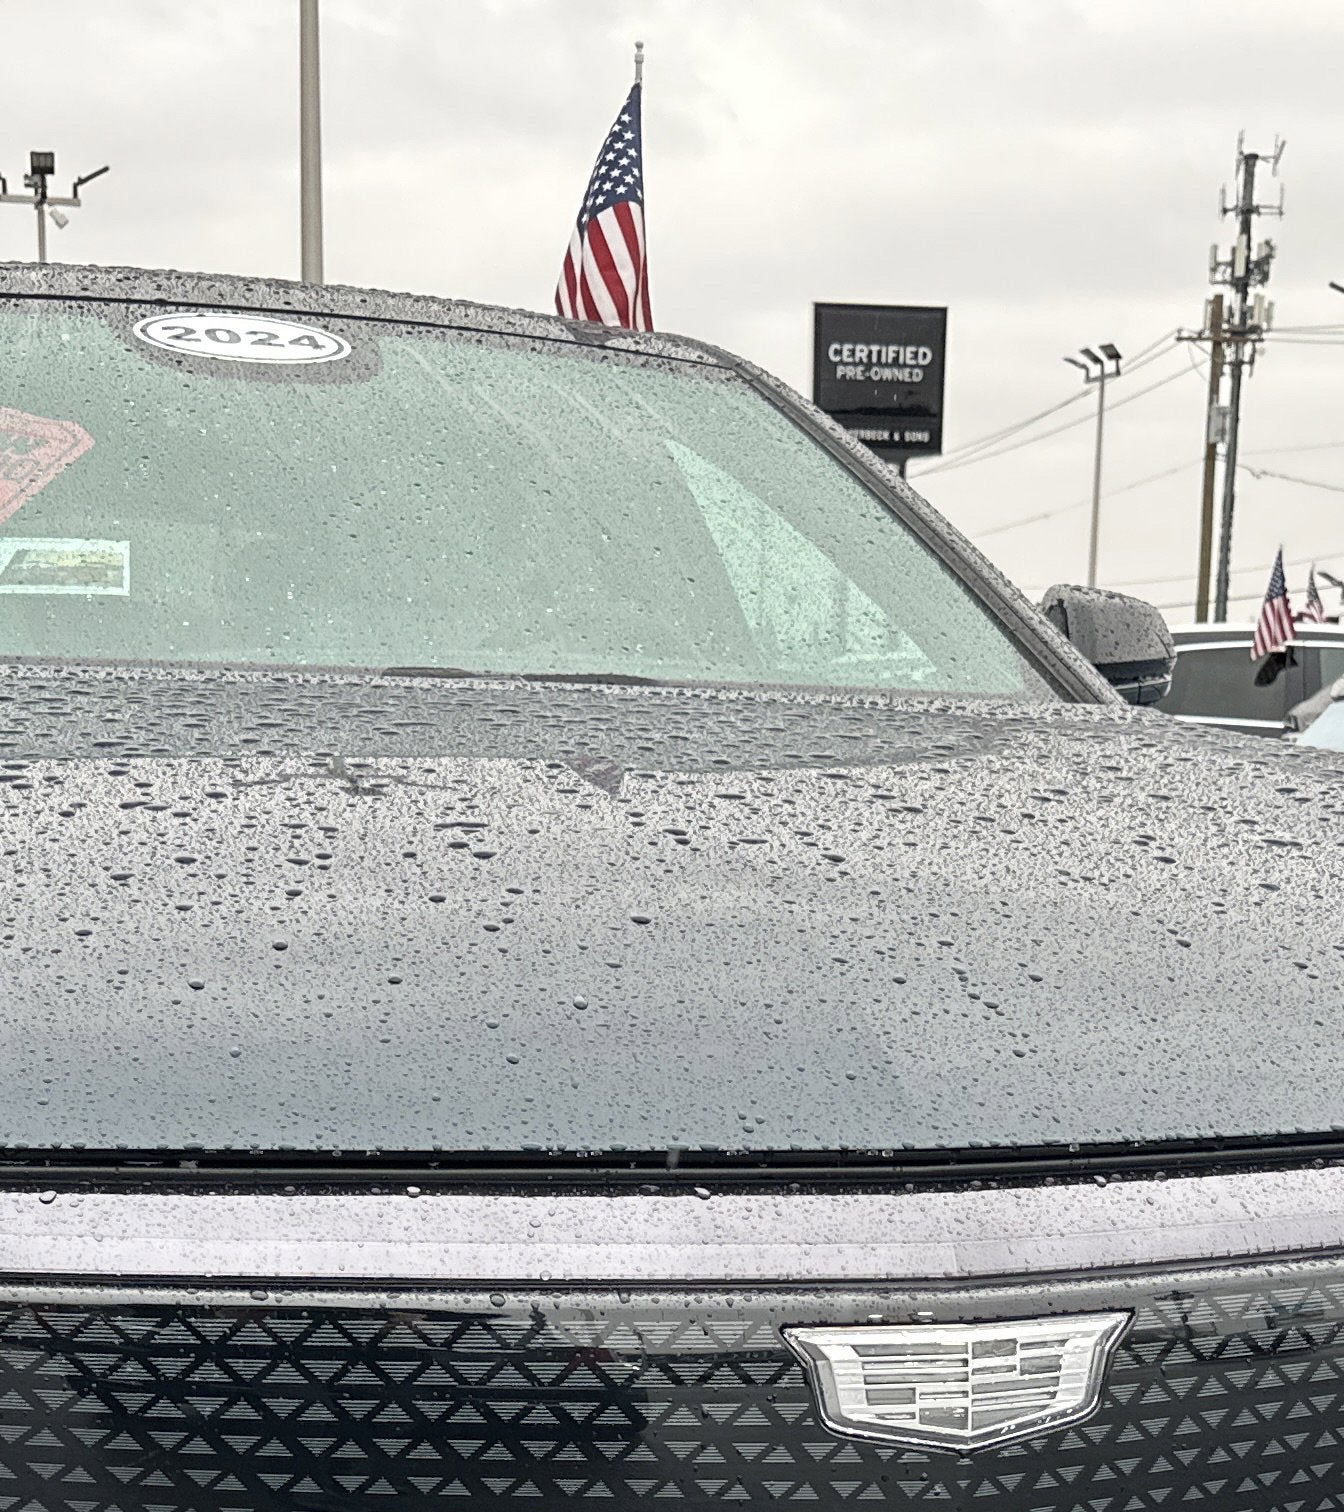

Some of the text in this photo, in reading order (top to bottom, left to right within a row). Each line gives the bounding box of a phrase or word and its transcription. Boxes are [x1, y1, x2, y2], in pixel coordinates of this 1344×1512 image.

[161, 325, 327, 351] 2024
[827, 342, 933, 366] CERTIFIED
[835, 364, 924, 383] PRE-OWNED
